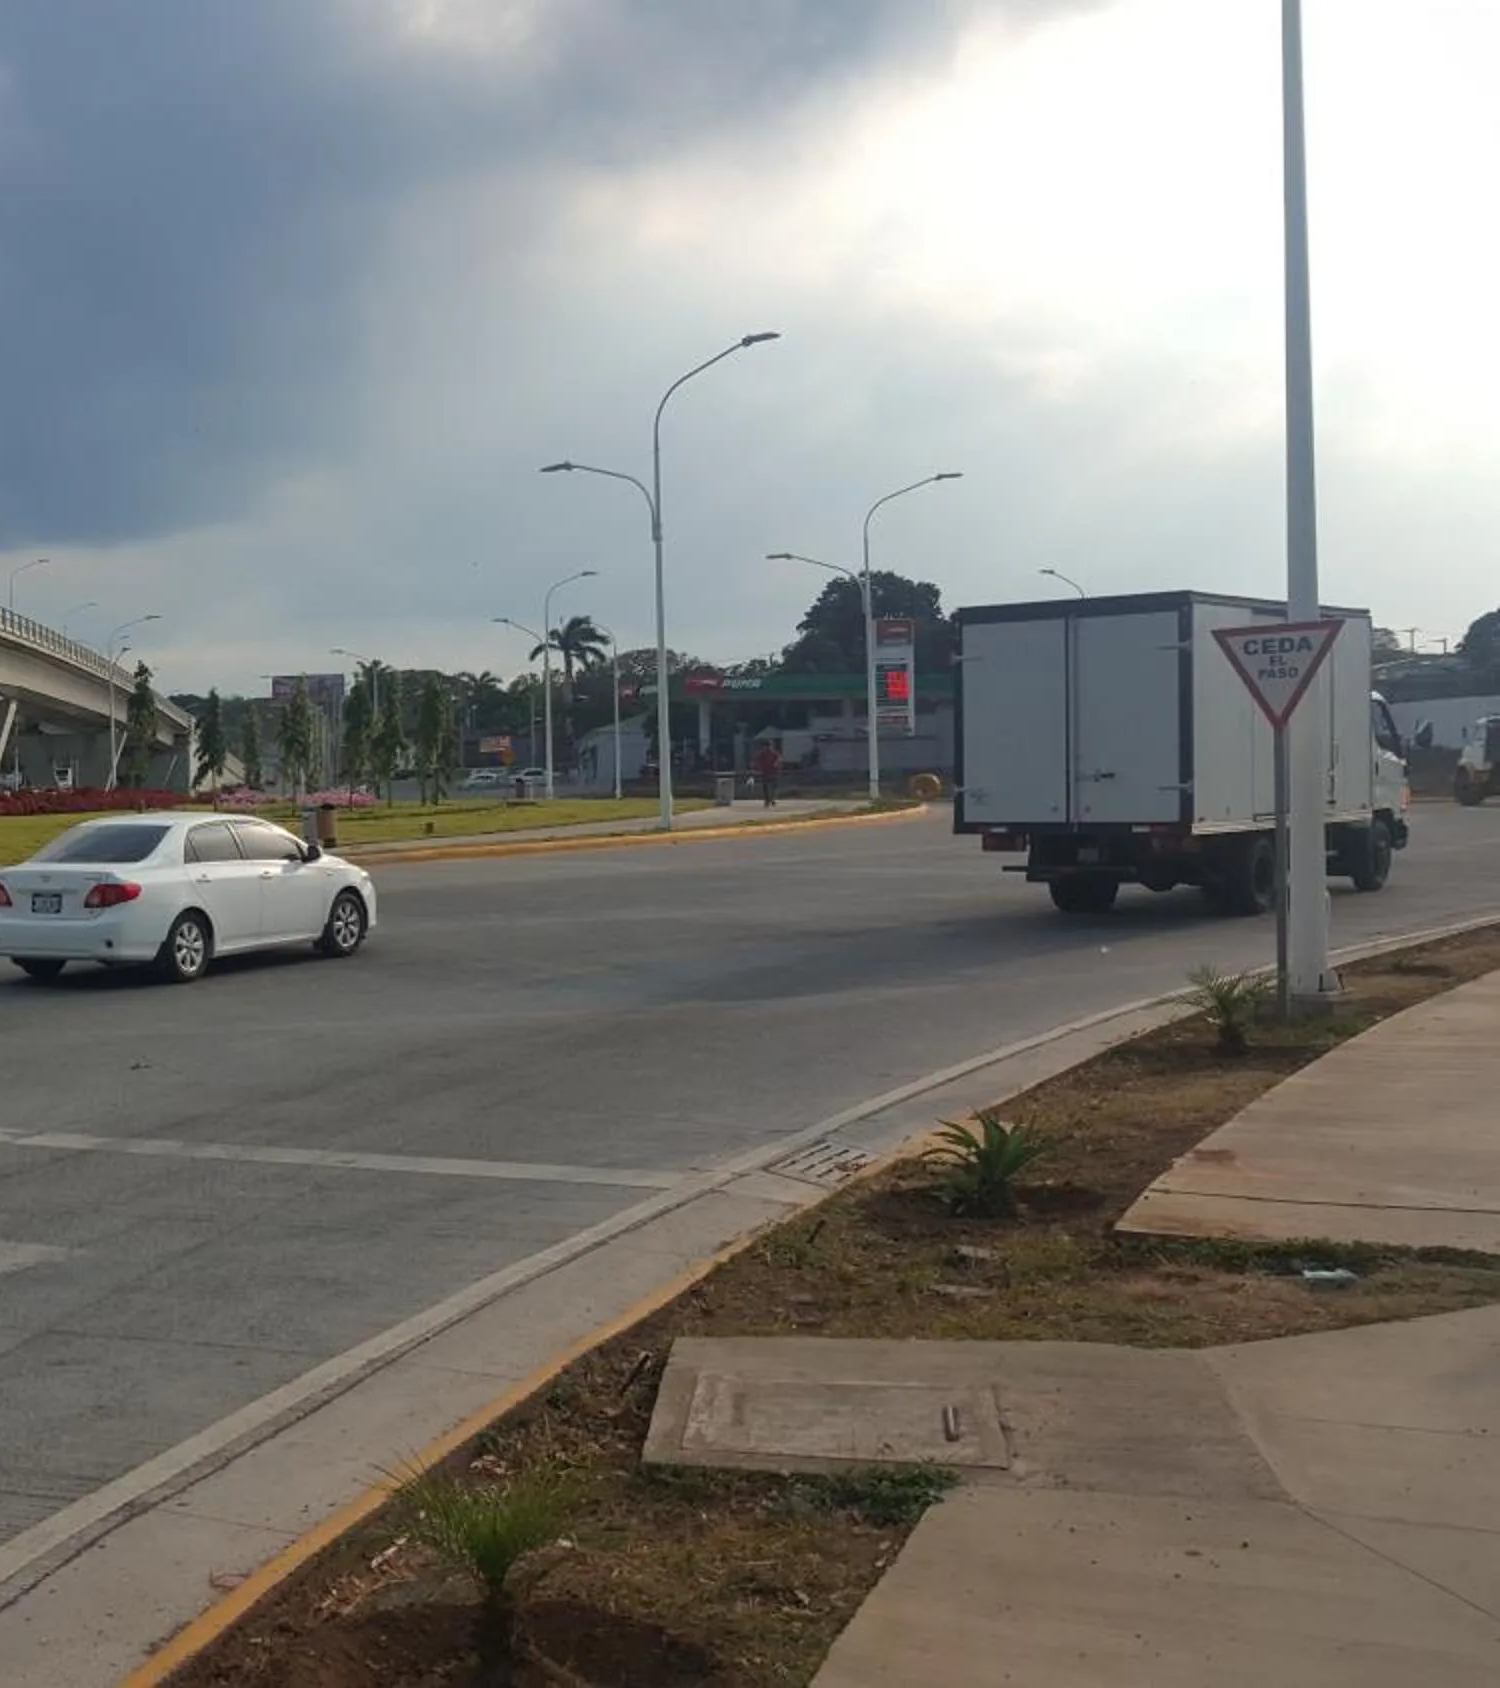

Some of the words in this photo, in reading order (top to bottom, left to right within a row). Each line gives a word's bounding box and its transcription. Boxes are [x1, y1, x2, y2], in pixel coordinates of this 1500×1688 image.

[1243, 636, 1313, 655] CEDA
[1269, 655, 1287, 666] EL
[1258, 667, 1299, 681] PASO
